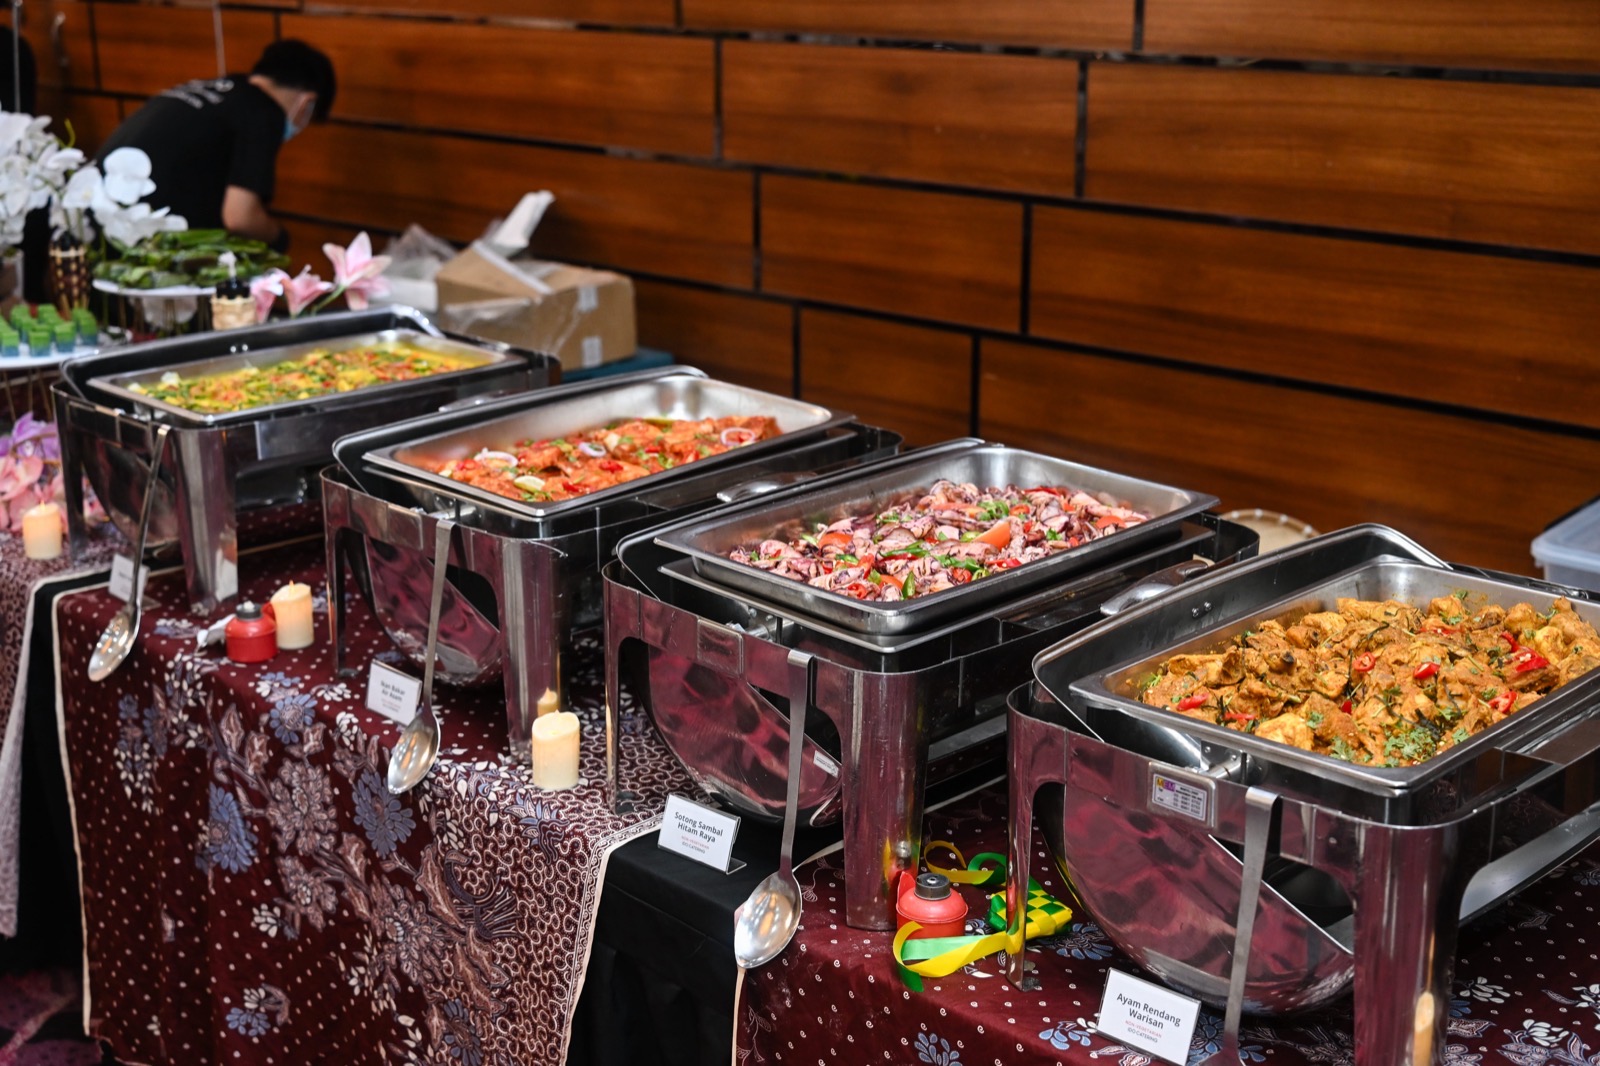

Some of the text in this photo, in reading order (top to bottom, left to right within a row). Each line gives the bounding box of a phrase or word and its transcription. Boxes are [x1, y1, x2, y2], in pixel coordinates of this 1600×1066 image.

[392, 685, 405, 695] Bakar
[675, 812, 724, 837] Sotong Sambal
[678, 822, 716, 843] Hitam Raya
[1117, 993, 1181, 1027] Ayam Rendang
[1129, 1008, 1164, 1029] Warisan
[1136, 1030, 1158, 1043] CATERING
